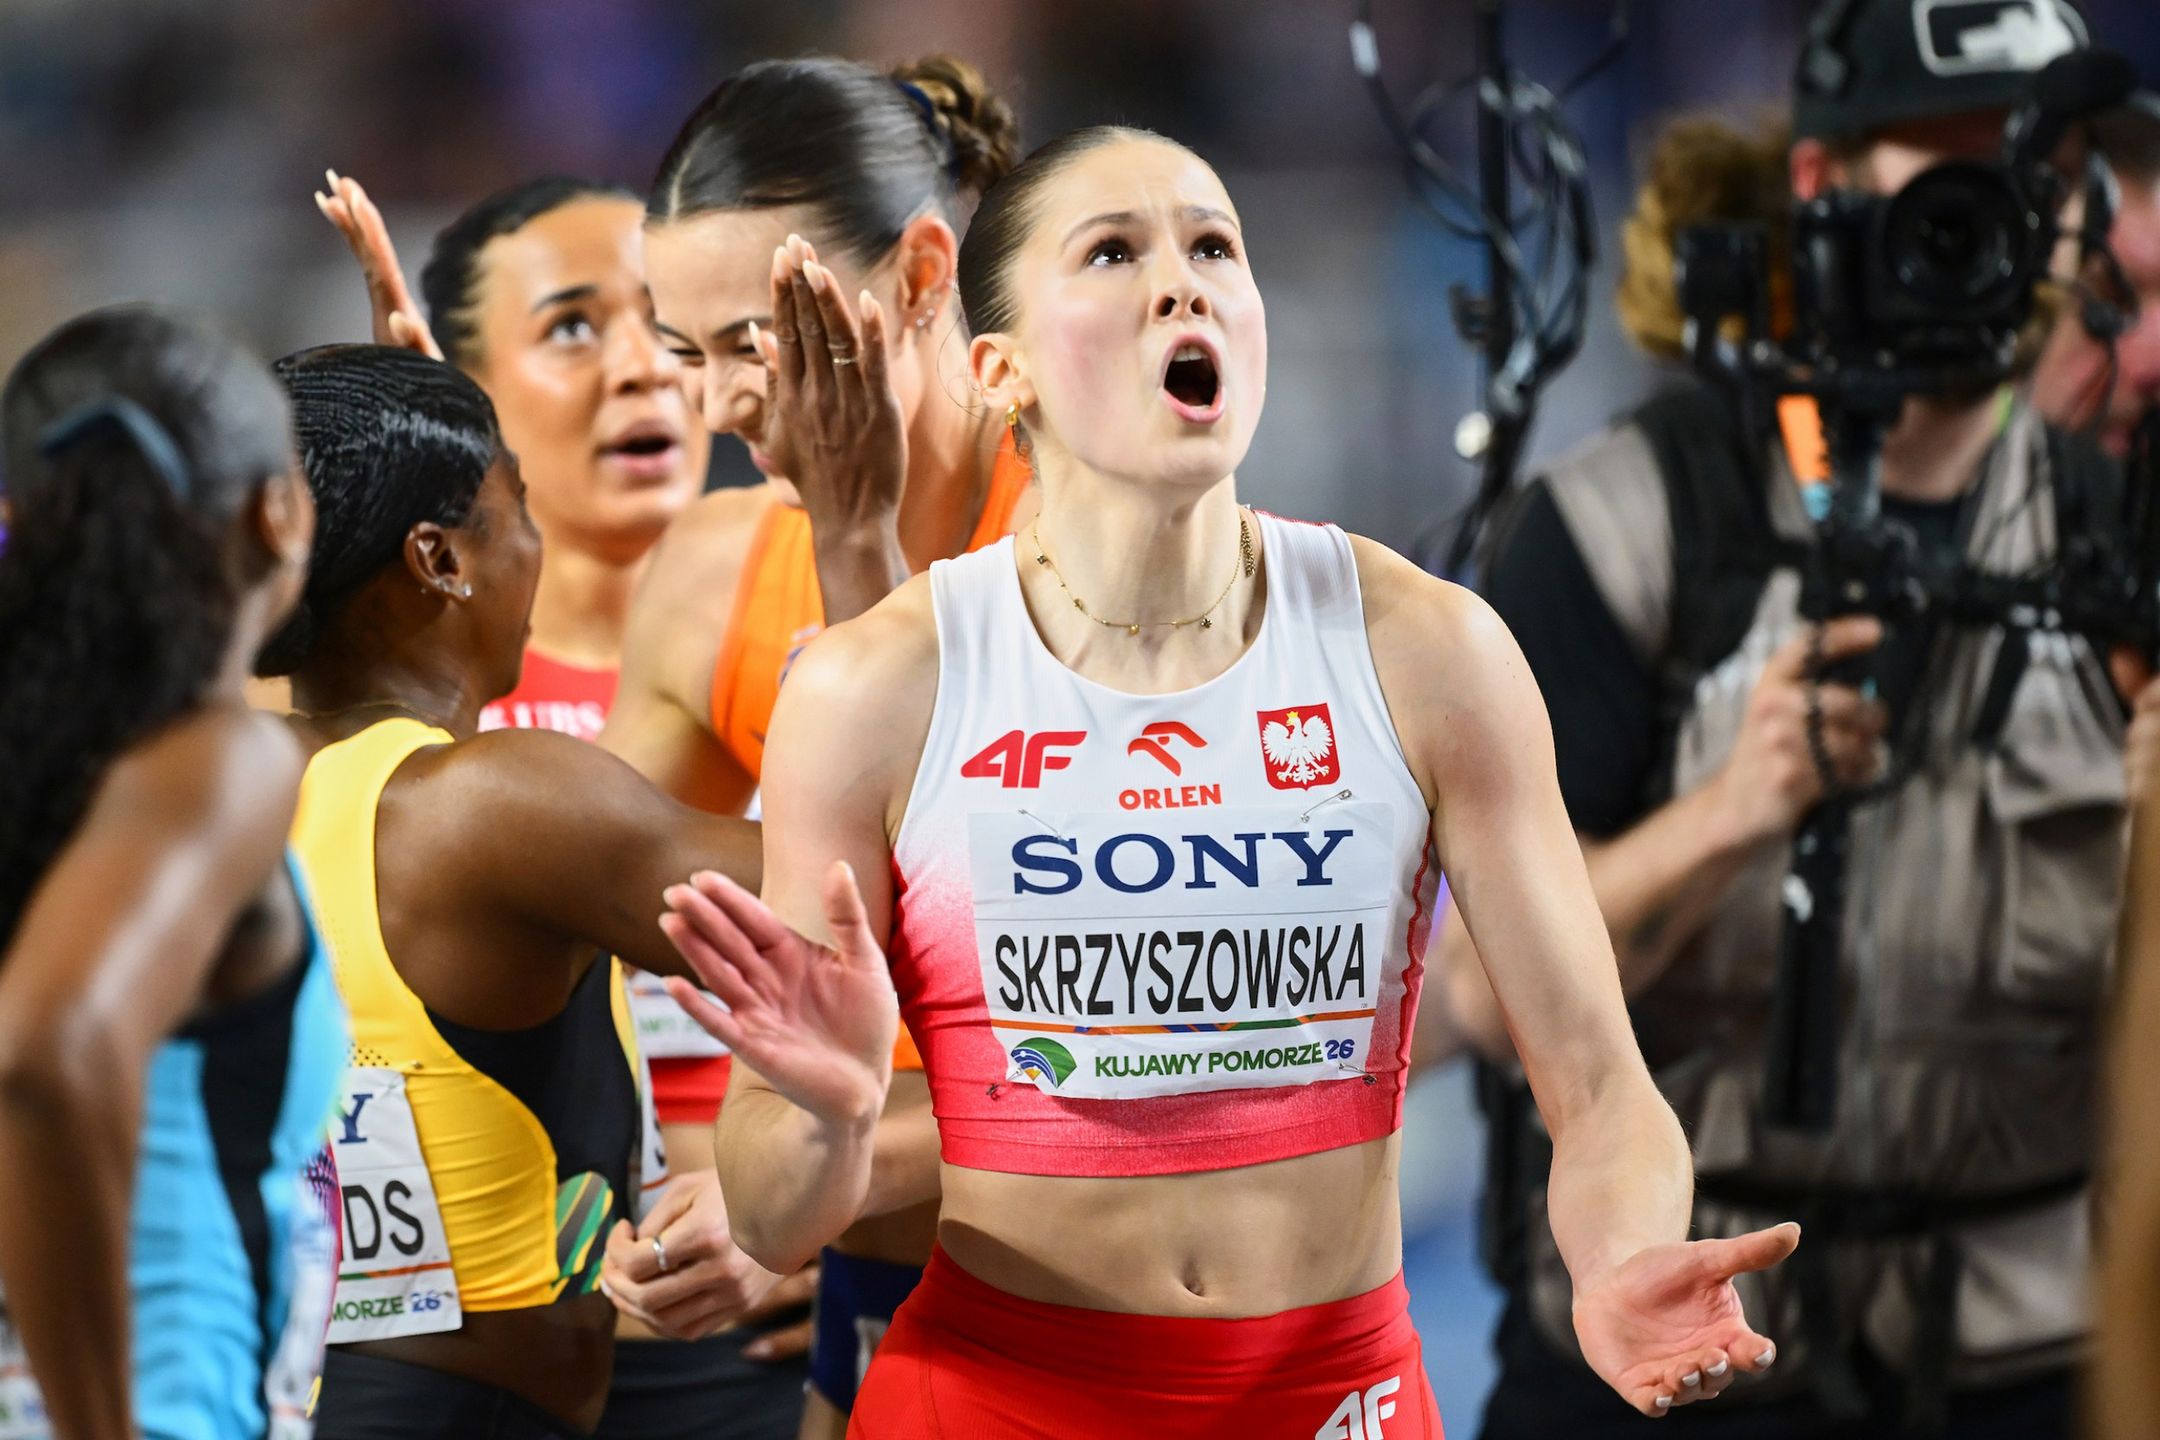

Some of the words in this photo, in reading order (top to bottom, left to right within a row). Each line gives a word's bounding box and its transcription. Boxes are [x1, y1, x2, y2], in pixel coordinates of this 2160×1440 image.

[961, 730, 1087, 788] 4F
[1119, 784, 1222, 810] ORLEN
[1011, 829, 1354, 894] SONY
[995, 923, 1365, 1015] SKRZYSZOWSKA
[1095, 1053, 1202, 1077] KUJAWY
[1208, 1042, 1324, 1073] POMORZE
[1324, 1039, 1355, 1060] 26
[337, 1180, 424, 1261] DS
[411, 1290, 441, 1312] 26
[1315, 1375, 1400, 1440] 4F
